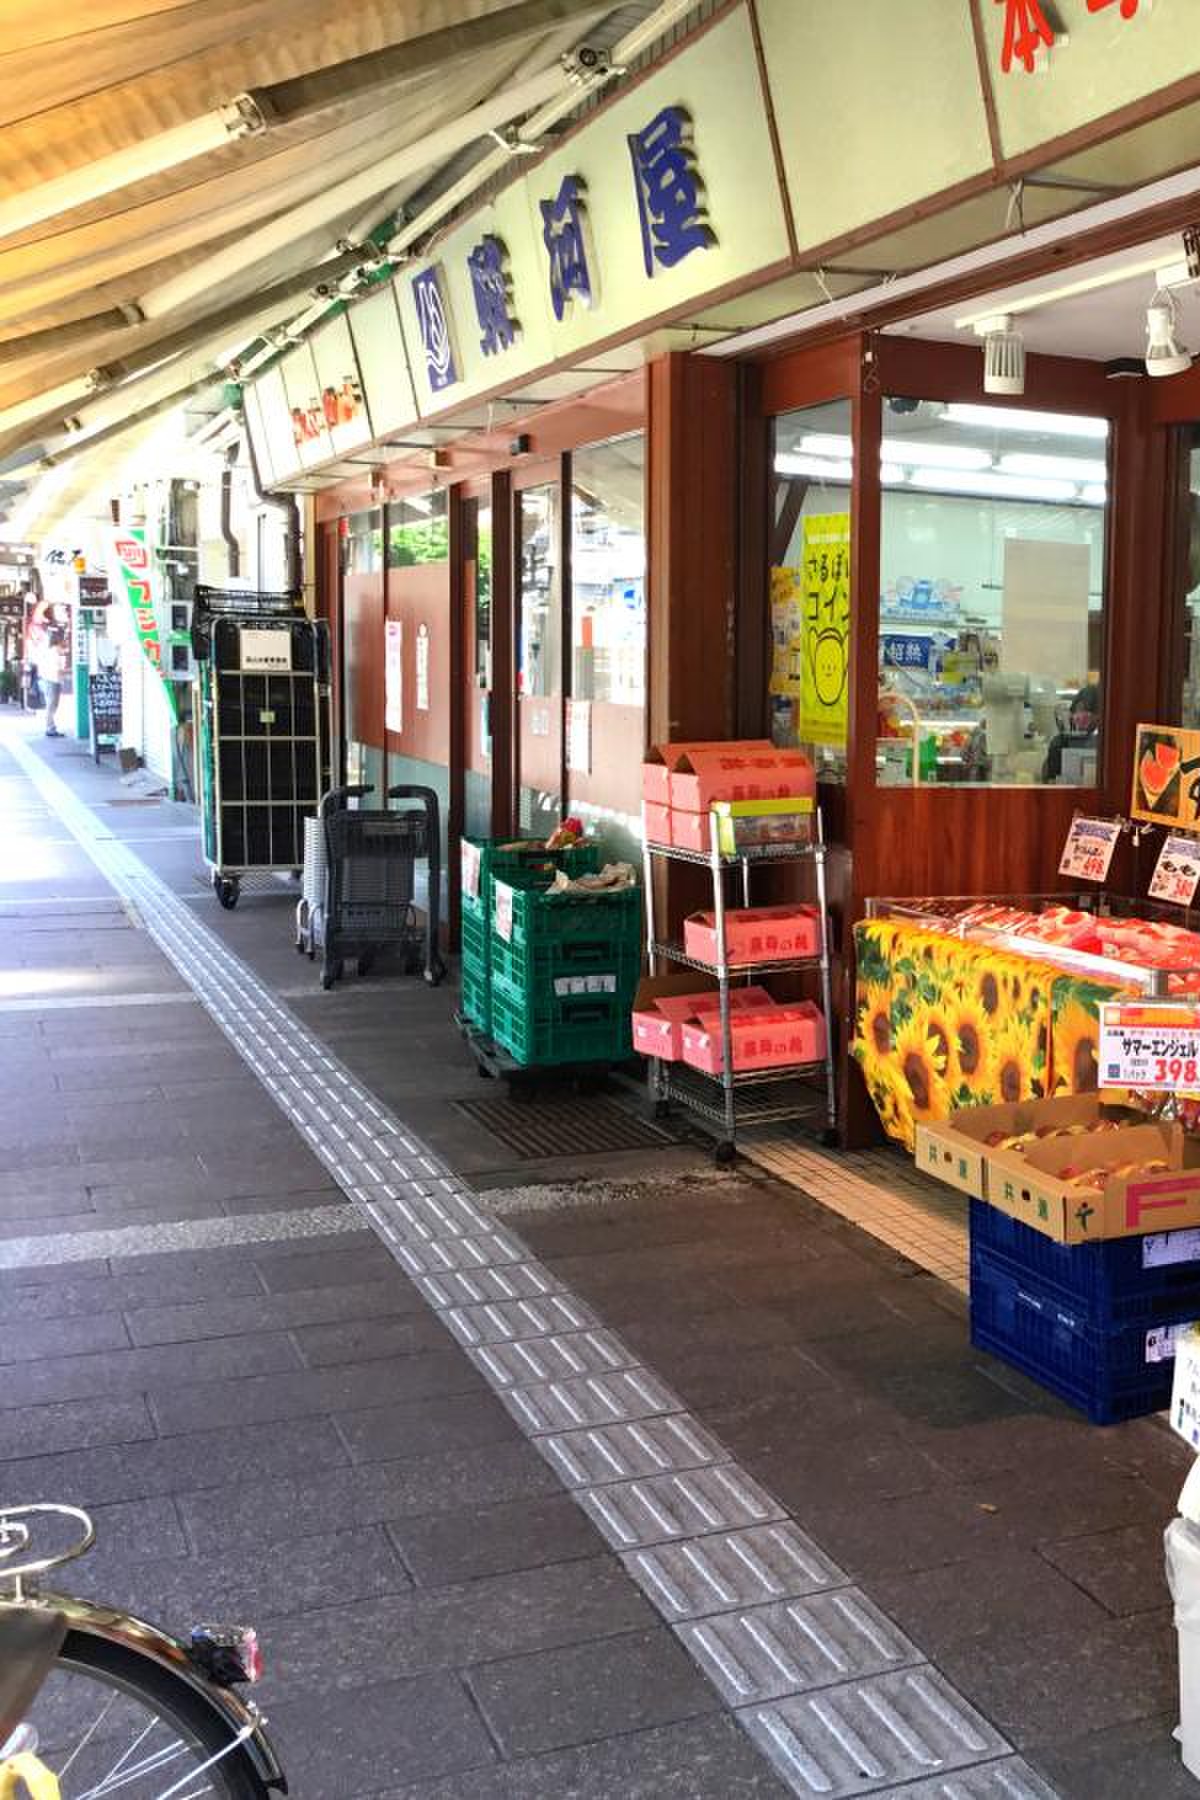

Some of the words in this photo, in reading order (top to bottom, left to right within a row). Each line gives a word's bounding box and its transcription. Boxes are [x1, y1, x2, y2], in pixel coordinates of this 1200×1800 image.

[807, 551, 849, 581] さるぼ
[1121, 1038, 1199, 1058] サマーエンジェル
[1153, 1059, 1198, 1083] 398
